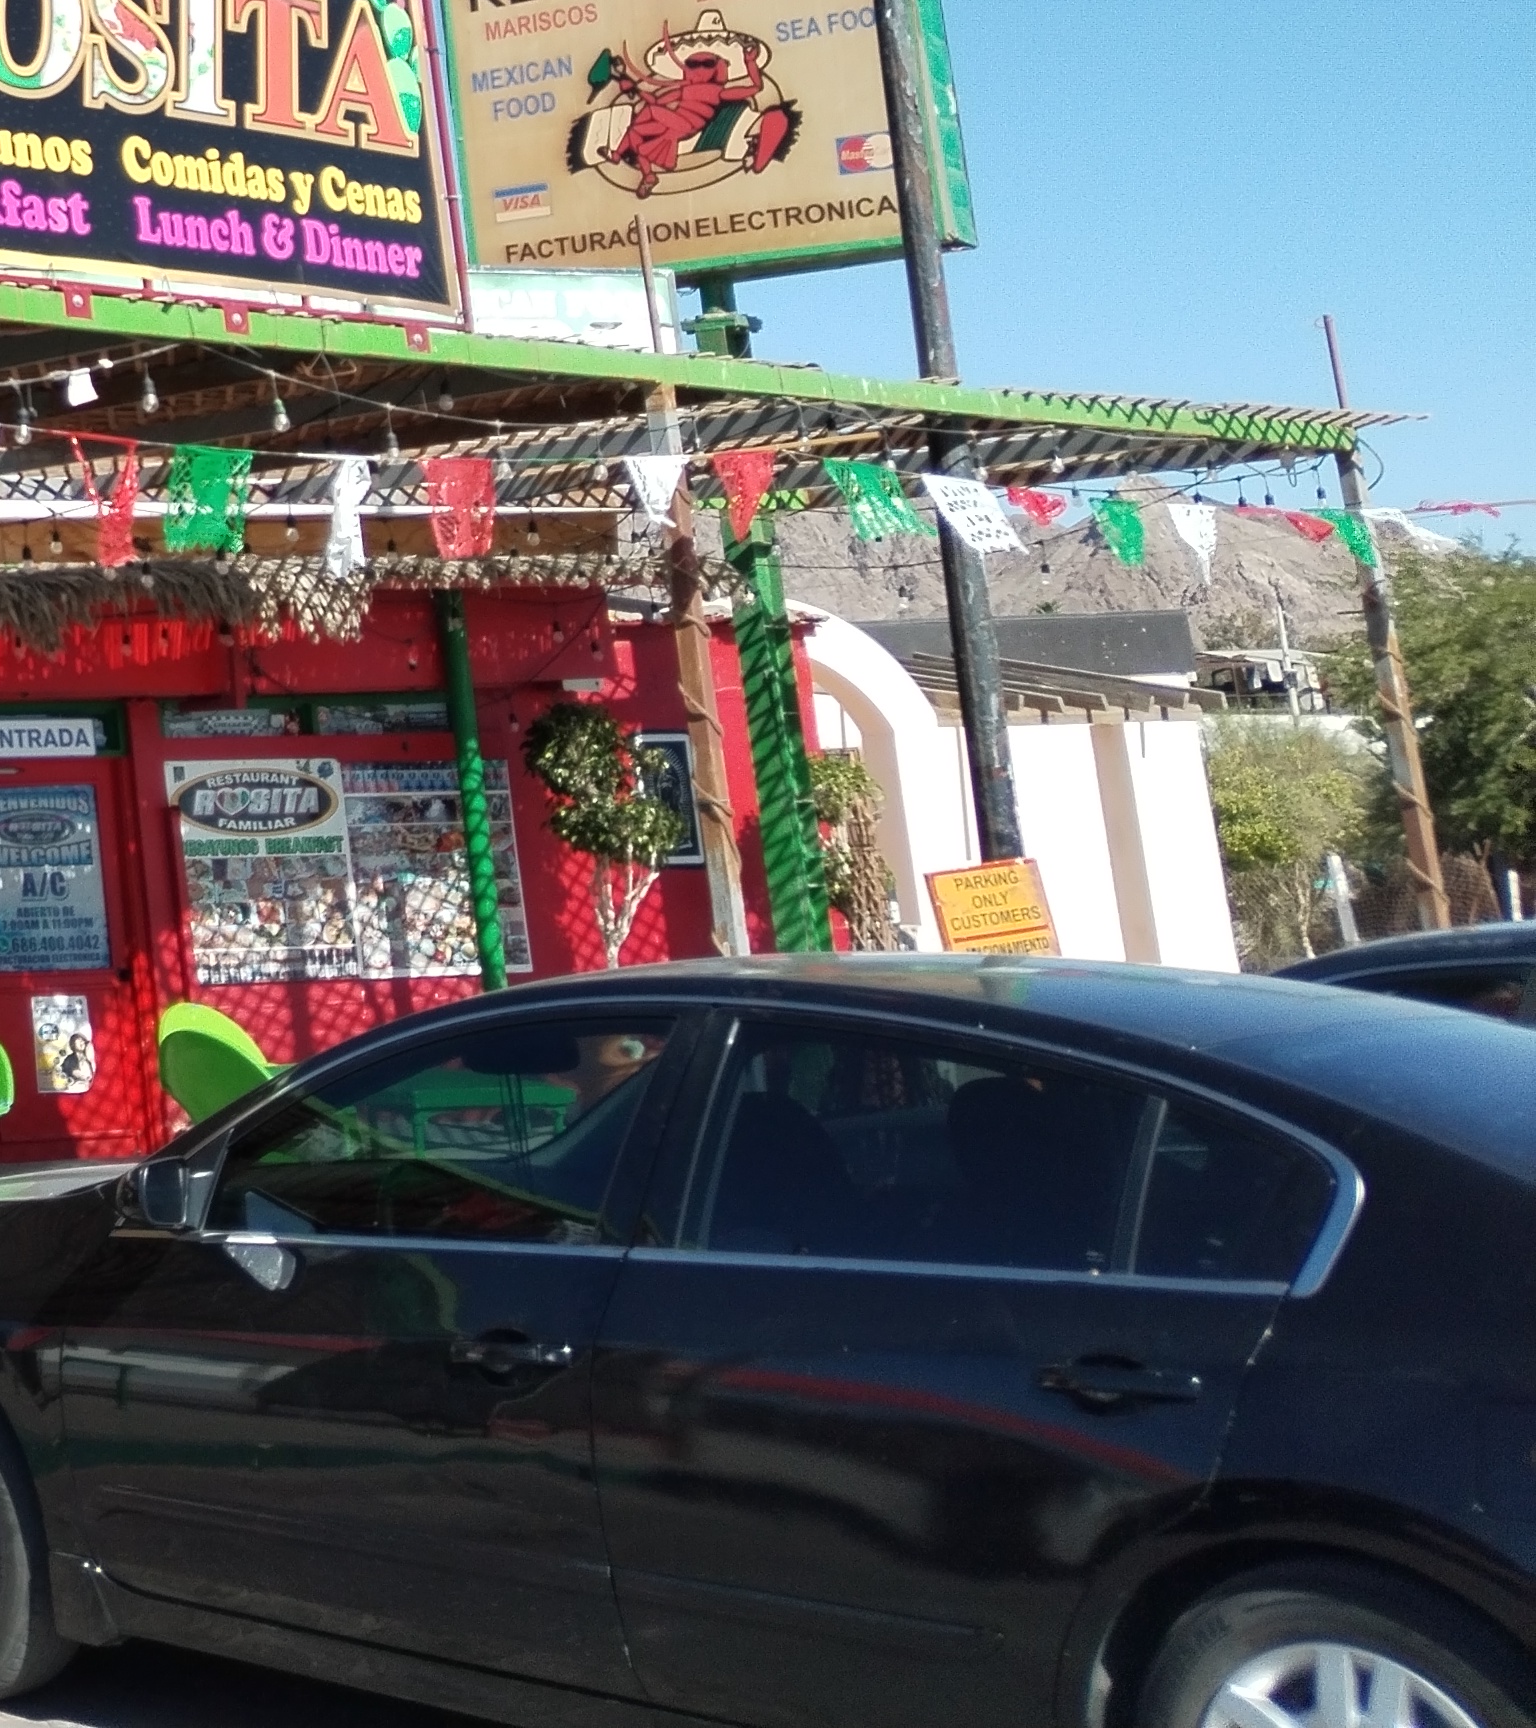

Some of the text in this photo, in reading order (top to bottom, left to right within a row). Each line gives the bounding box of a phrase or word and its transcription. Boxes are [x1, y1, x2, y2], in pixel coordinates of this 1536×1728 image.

[485, 3, 598, 41] MARISCOS
[775, 6, 877, 43] SEA FOO
[471, 56, 573, 94] MEXICAN
[492, 91, 557, 121] FOOD
[123, 136, 285, 206] Comidas
[292, 169, 314, 214] y
[319, 172, 422, 225] Cenas
[502, 193, 541, 212] VISA
[134, 195, 253, 258] Lunch
[262, 214, 294, 256] &
[303, 217, 423, 278] Dinner
[206, 772, 300, 788] RESTAURANT
[218, 817, 296, 831] FAMILIAR
[22, 871, 68, 900] A/C
[953, 870, 1019, 891] PARKING
[16, 906, 75, 918] ABIERTO DE
[972, 891, 1009, 909] ONLY
[950, 906, 1041, 931] CUSTOMERS
